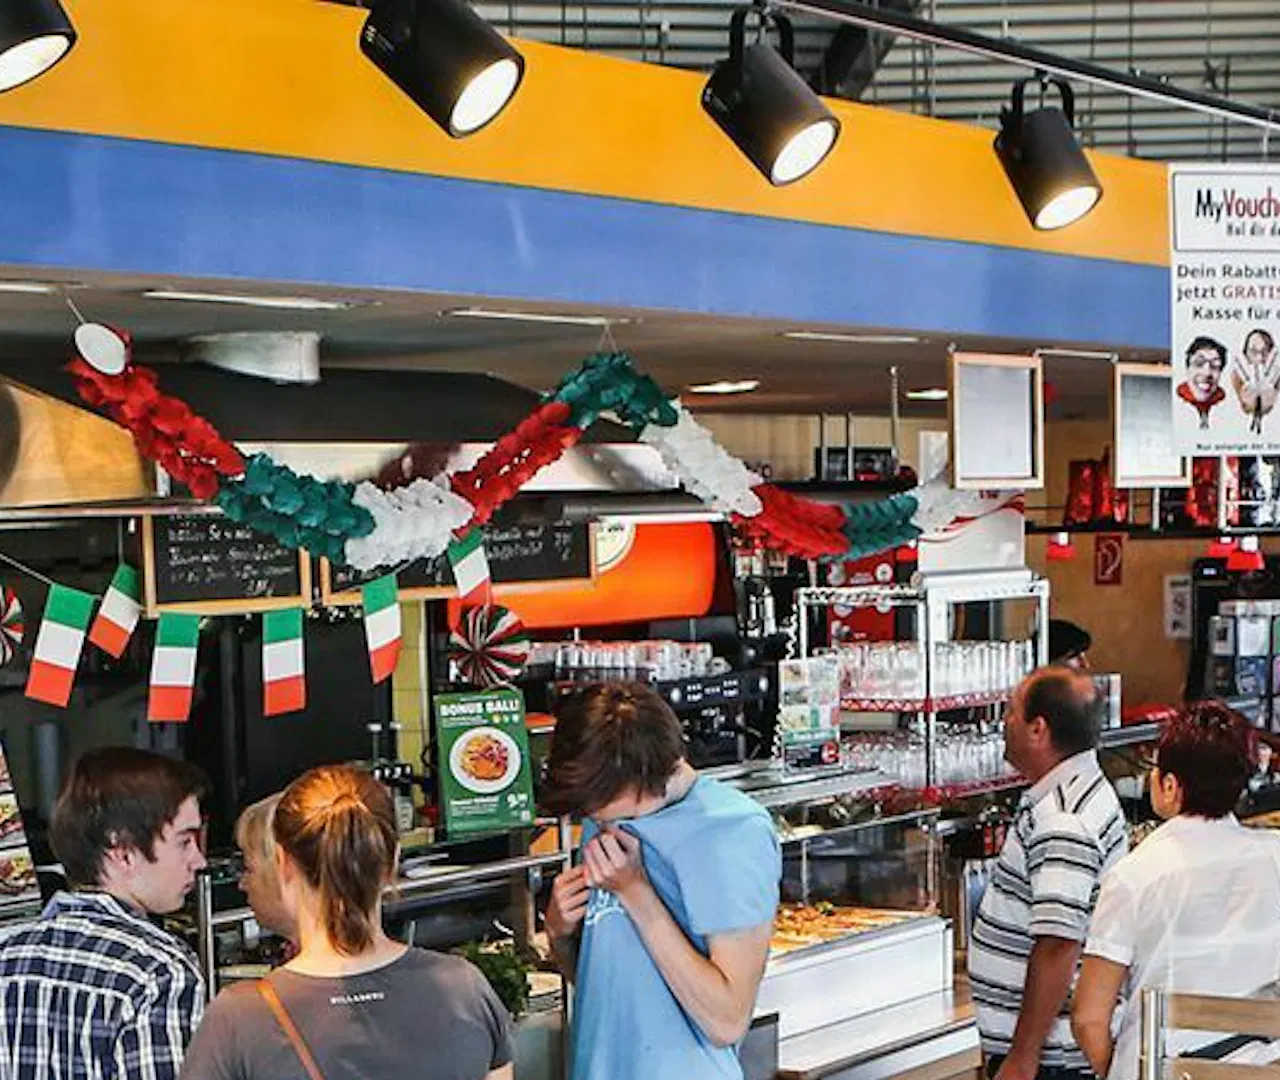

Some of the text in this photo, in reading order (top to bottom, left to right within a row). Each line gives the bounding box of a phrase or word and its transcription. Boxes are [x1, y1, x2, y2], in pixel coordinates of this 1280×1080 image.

[1177, 264, 1217, 279] Dein
[1177, 285, 1217, 302] jetzt
[1192, 306, 1243, 321] Kasse
[1247, 305, 1271, 321] für
